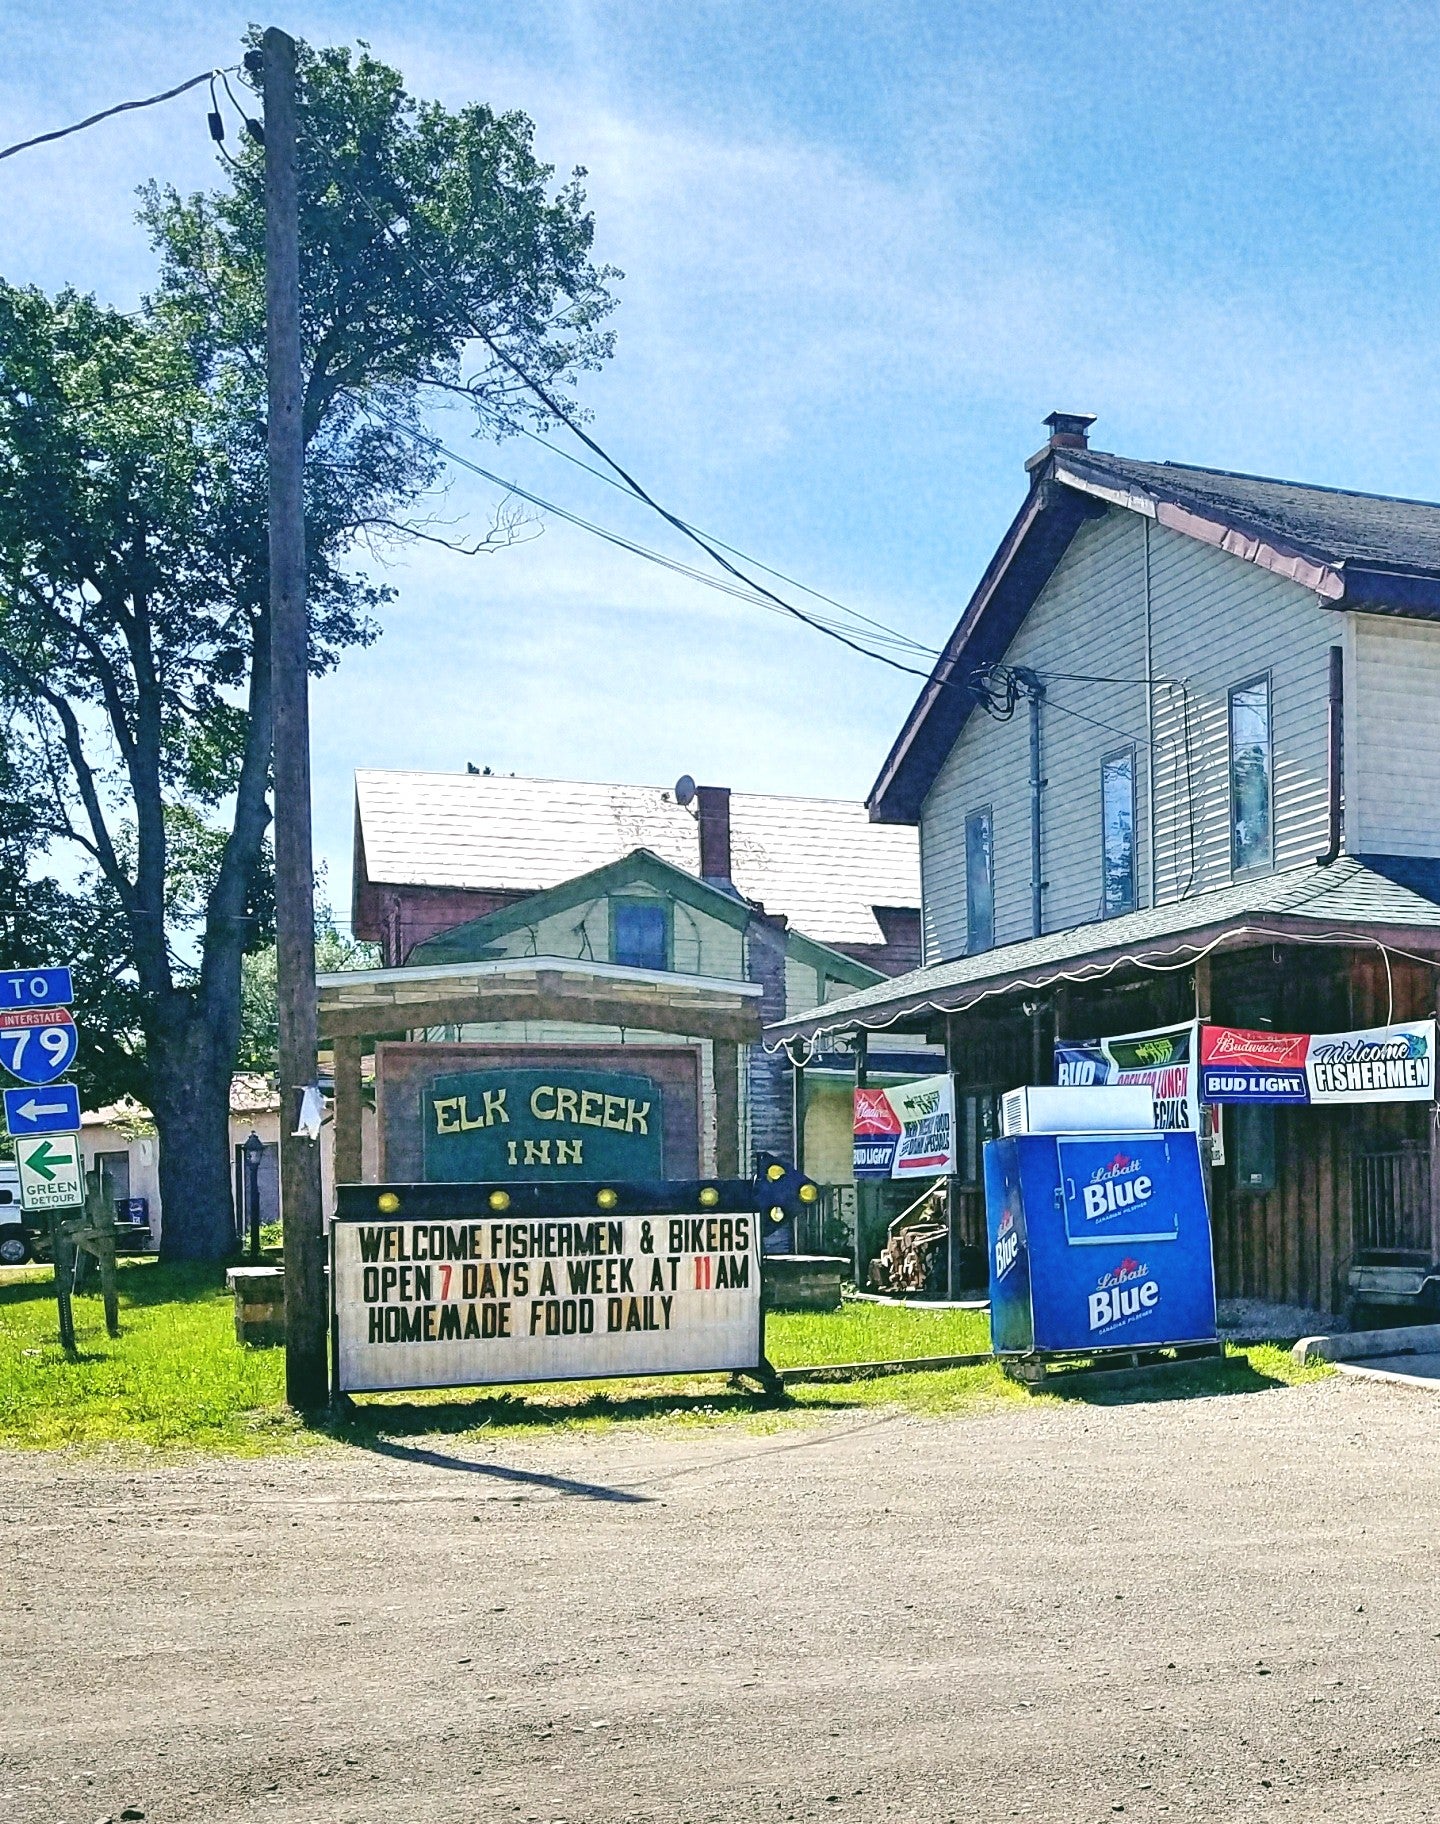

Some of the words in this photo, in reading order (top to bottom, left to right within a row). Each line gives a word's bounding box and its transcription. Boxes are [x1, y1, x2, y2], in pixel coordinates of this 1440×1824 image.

[7, 976, 48, 999] TO
[4, 1012, 62, 1026] INTERSTATE
[0, 1027, 69, 1070] 79
[1217, 1036, 1295, 1054] Budweiser
[1313, 1039, 1410, 1064] Welcome
[1058, 1060, 1097, 1085] BUD
[1155, 1067, 1188, 1099] LUNCH
[1208, 1077, 1248, 1092] BUD
[1249, 1077, 1301, 1092] LIGHT
[1314, 1057, 1430, 1092] FISHERMEN
[433, 1088, 510, 1135] ELK
[530, 1085, 651, 1135] CREEK
[1153, 1099, 1190, 1129] ECIALS
[507, 1139, 583, 1165] INN
[865, 1148, 893, 1165] LIGHT
[1090, 1159, 1142, 1184] Labatt
[26, 1182, 78, 1196] GREEN
[31, 1194, 76, 1205] DETOUR
[1083, 1175, 1153, 1220] Blue
[358, 1225, 482, 1263] WELCOME
[491, 1221, 623, 1259] FISHERMEN
[639, 1224, 655, 1254] &
[669, 1218, 749, 1255] BIKERS
[995, 1231, 1018, 1279] Blue
[363, 1265, 431, 1303] OPEN
[438, 1264, 453, 1301] 7
[462, 1261, 529, 1300] DAYS
[539, 1261, 556, 1297] A
[566, 1258, 634, 1295] WEEK
[650, 1255, 681, 1292] AT
[1096, 1263, 1150, 1291] Labatt
[1087, 1280, 1159, 1331] Blue
[368, 1302, 511, 1344] HOMEMADE
[530, 1297, 594, 1336] FOOD
[607, 1296, 673, 1333] DAILY
